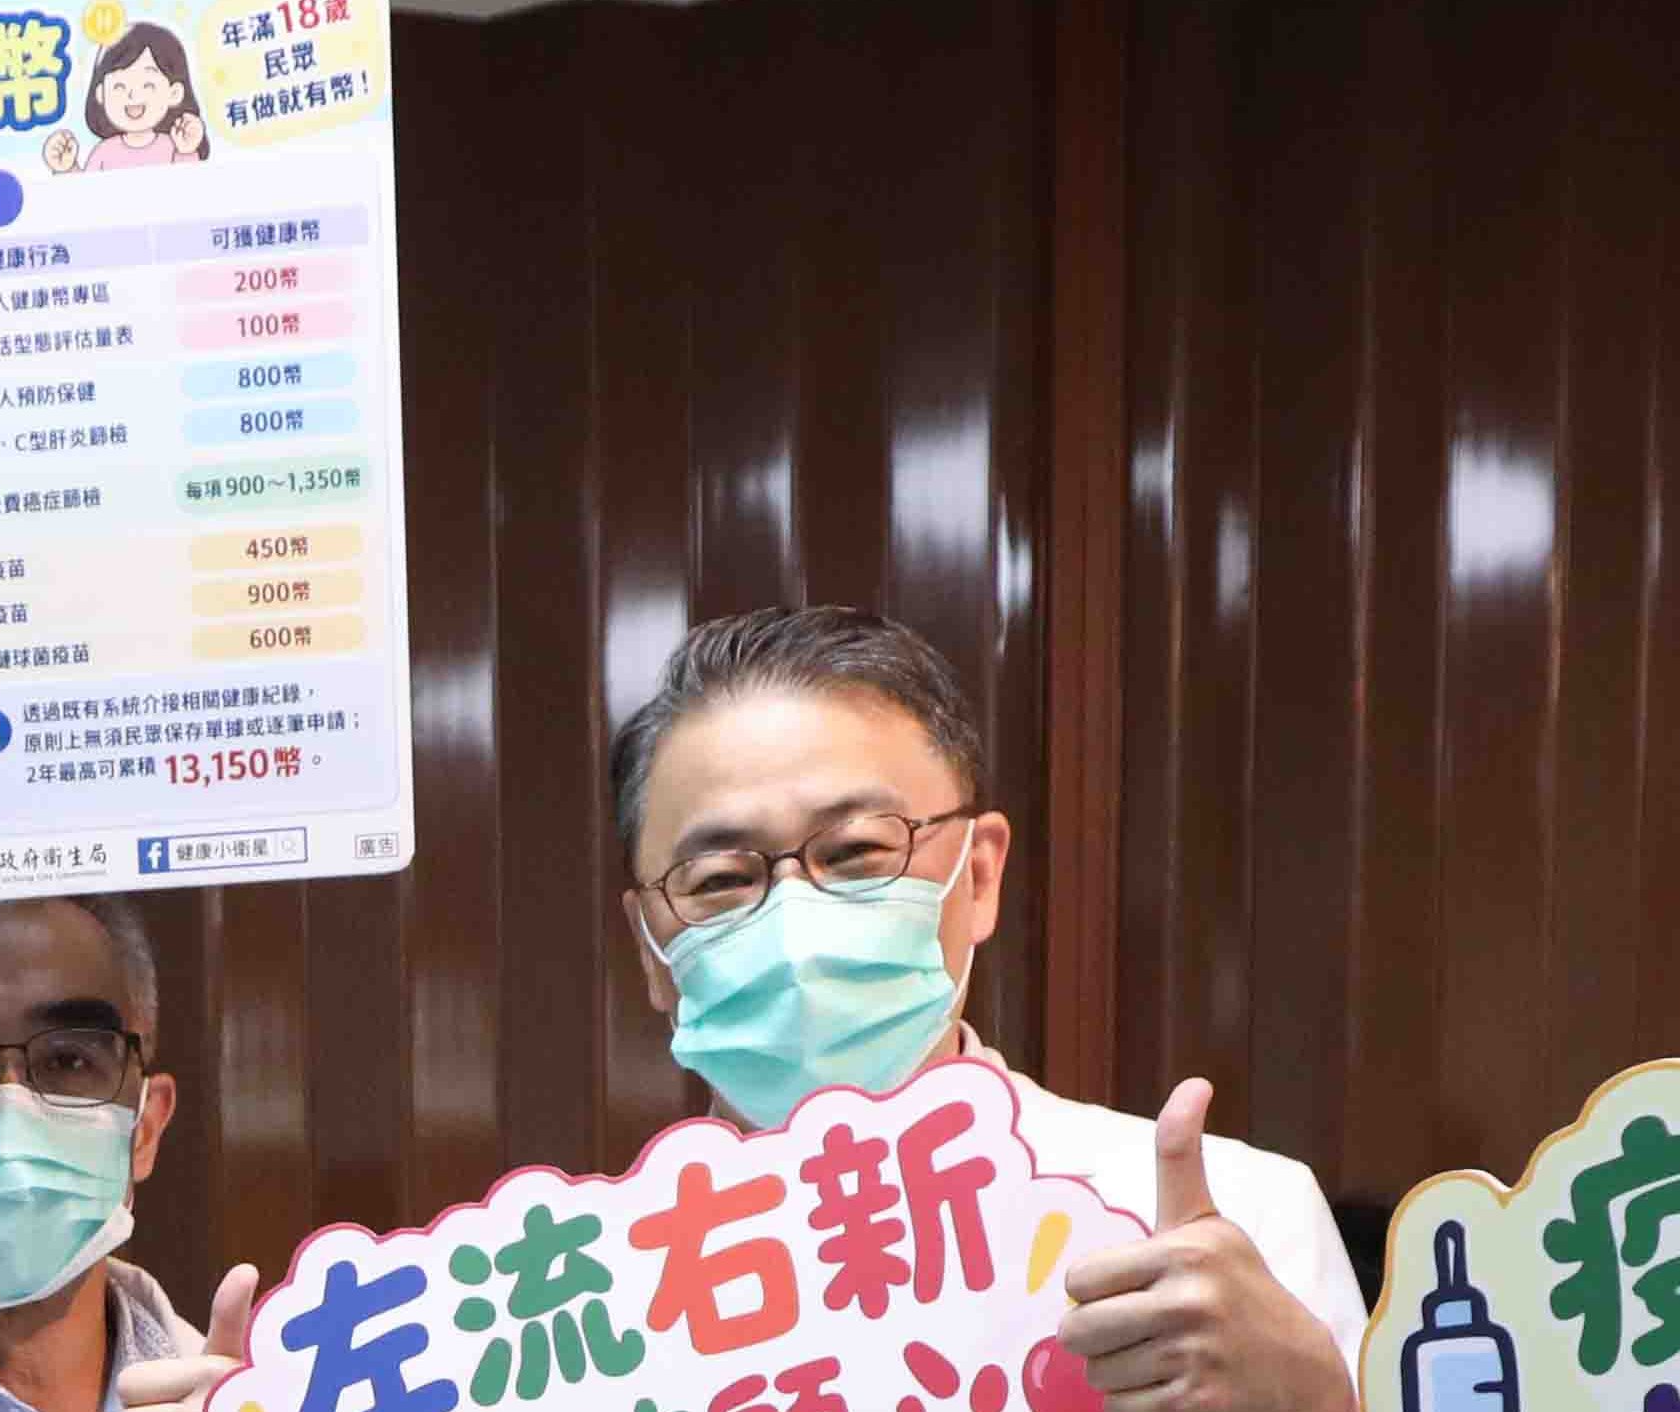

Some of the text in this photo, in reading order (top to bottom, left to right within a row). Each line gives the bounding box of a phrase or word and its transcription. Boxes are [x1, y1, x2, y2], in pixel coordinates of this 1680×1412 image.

[222, 0, 351, 48] 年滿18歲
[264, 41, 317, 79] 民眾
[210, 220, 321, 250] 可獲健康幣
[234, 266, 299, 291] 200幣
[236, 313, 301, 337] 100幣
[238, 364, 303, 389] 800幣
[240, 409, 304, 435] 800幣
[245, 536, 309, 559] 450幣
[247, 580, 310, 605] 900幣
[249, 625, 312, 650] 600幣
[176, 839, 267, 861] 健康小衛星
